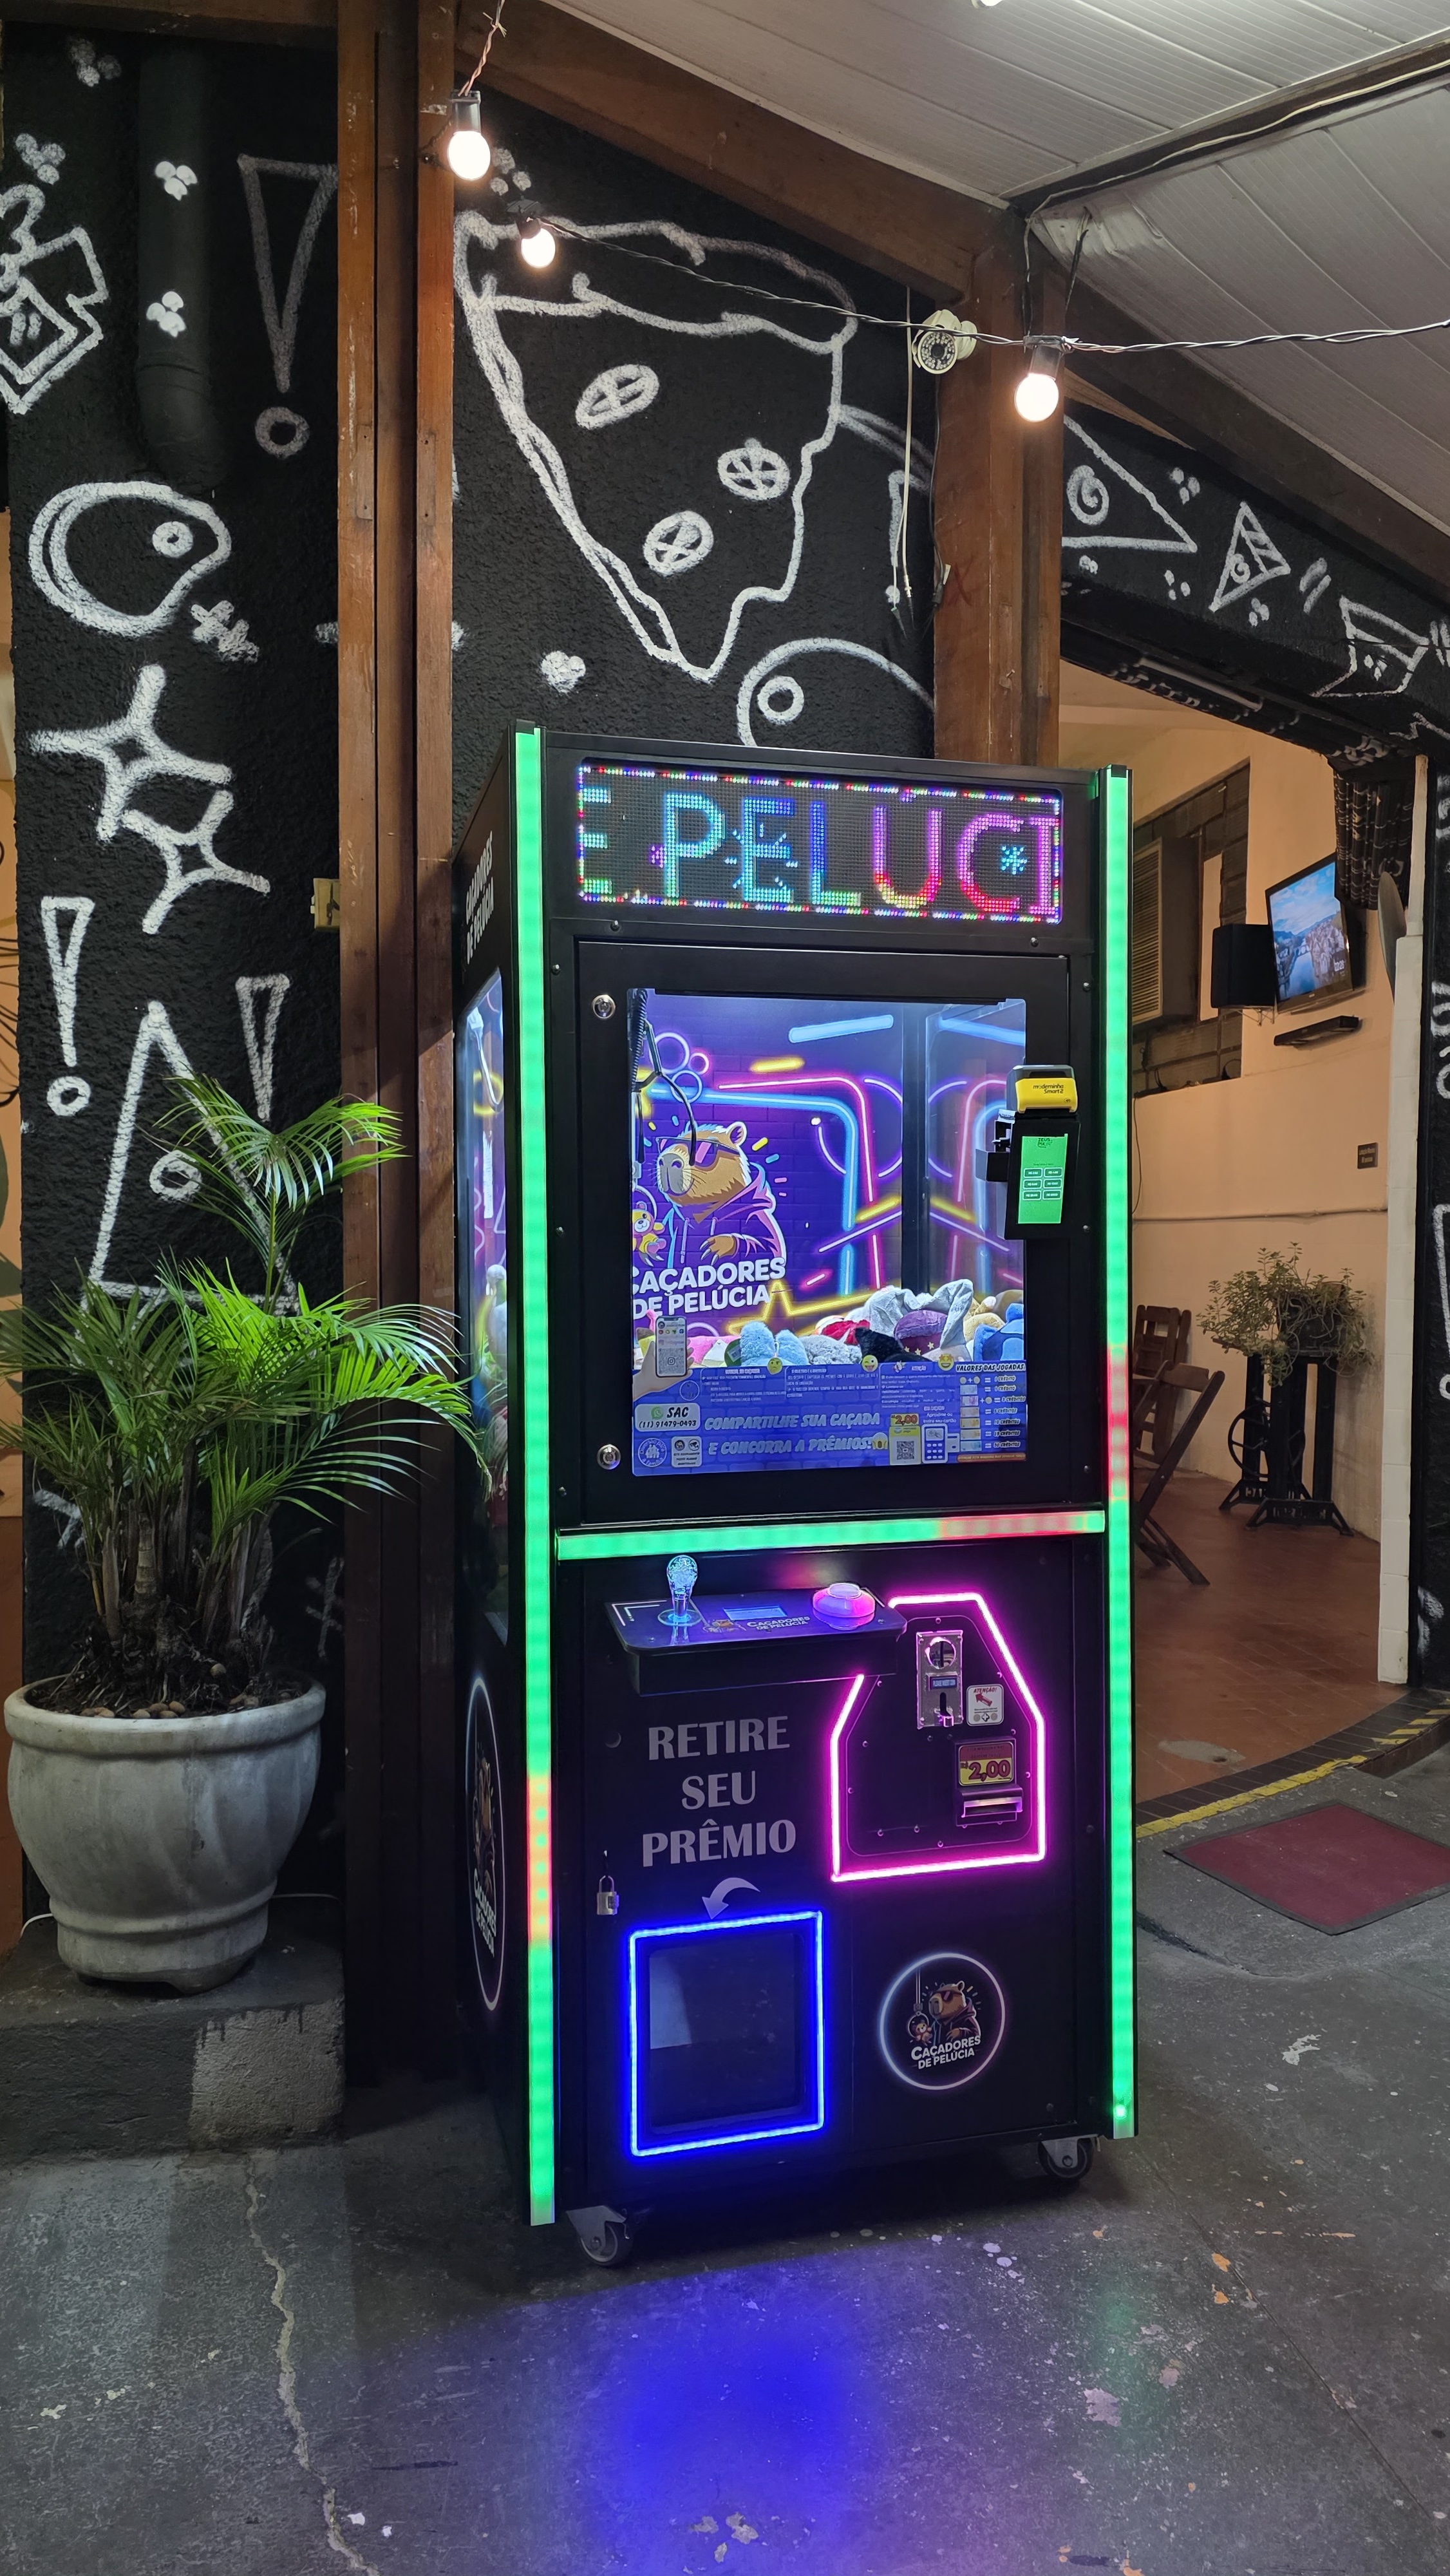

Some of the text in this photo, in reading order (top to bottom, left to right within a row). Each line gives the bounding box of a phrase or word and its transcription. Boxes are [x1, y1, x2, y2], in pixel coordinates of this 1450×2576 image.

[668, 1285, 770, 1315] PELÚCIA
[667, 1407, 688, 1417] SAC
[705, 1413, 880, 1430] COMPARTILHE SUA CAÇADA
[708, 1443, 719, 1455] E
[720, 1440, 791, 1455] CONCORRA
[795, 1439, 804, 1452] A
[649, 1716, 790, 1760] RETIRE
[968, 1759, 1010, 1782] 2,00
[682, 1771, 755, 1810] SEU
[643, 1819, 796, 1867] PRÊMIO
[911, 2035, 981, 2060] CAÇADORES
[918, 2048, 975, 2069] DE PELÚCIA
